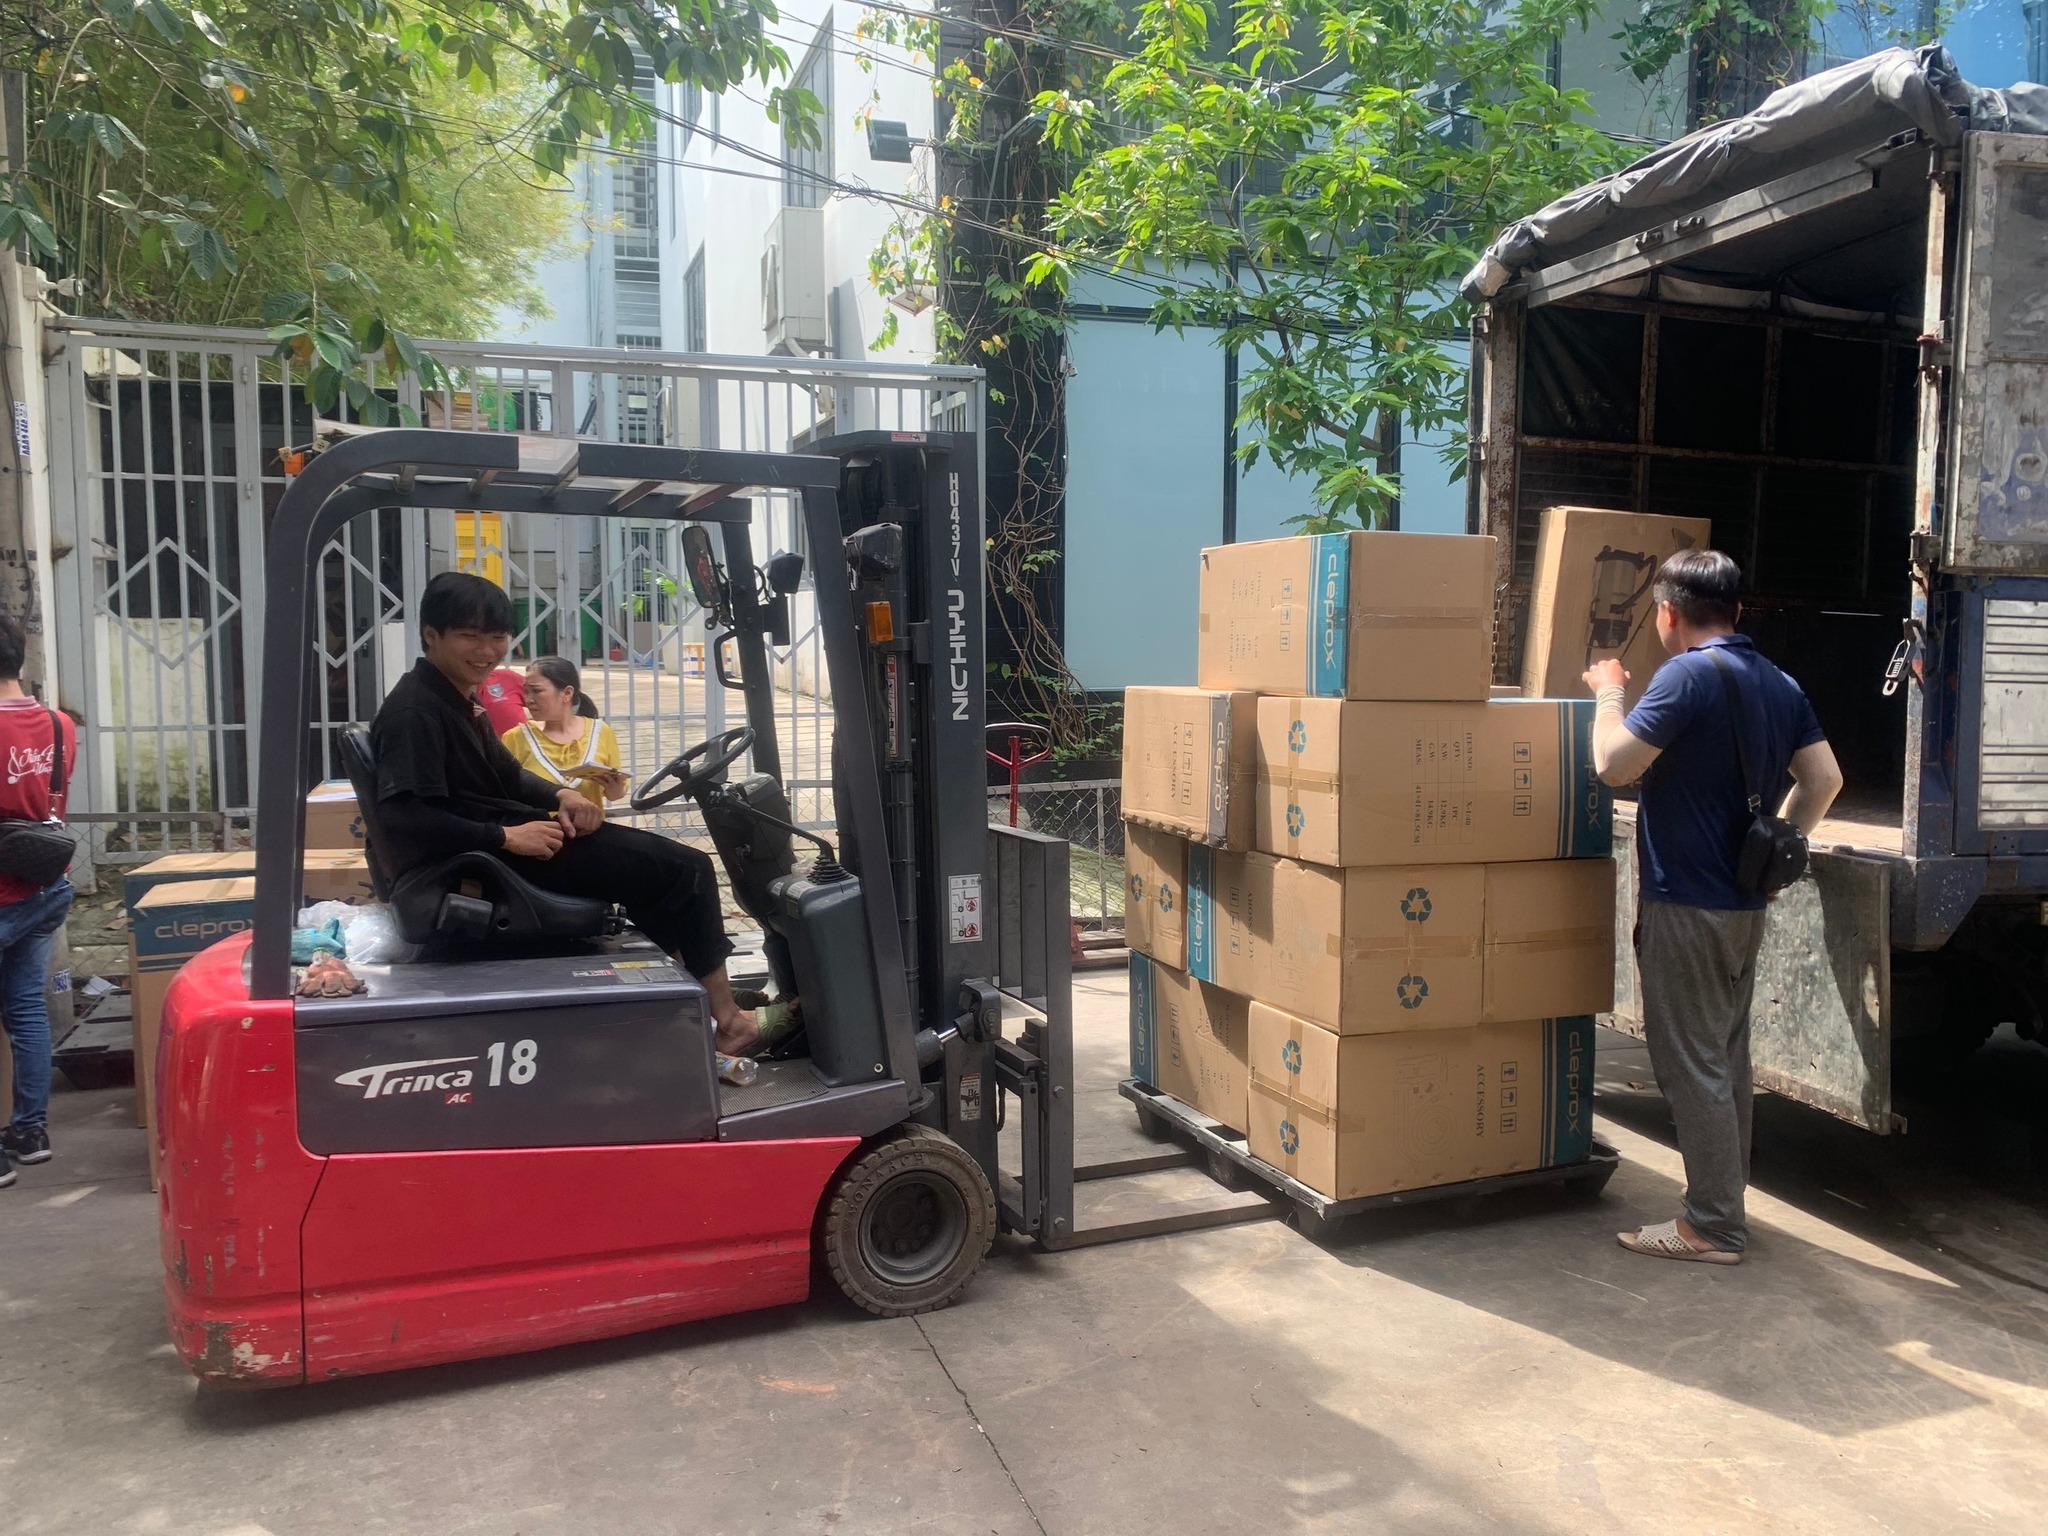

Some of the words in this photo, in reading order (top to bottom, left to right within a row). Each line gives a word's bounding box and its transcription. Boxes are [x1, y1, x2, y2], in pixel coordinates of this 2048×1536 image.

[1322, 553, 1339, 670] cleprox
[948, 589, 969, 721] NICHIYU
[1194, 864, 1204, 963] cleprox
[1247, 890, 1255, 962] ACCESSORY
[1134, 974, 1146, 1066] cleprox
[334, 1055, 479, 1100] Trinca
[487, 1039, 538, 1087] 18
[446, 1093, 471, 1105] AC
[1476, 1064, 1485, 1139] ACCESSORY
[1566, 1031, 1583, 1136] cleprox
[847, 1152, 926, 1215] MONARCH
